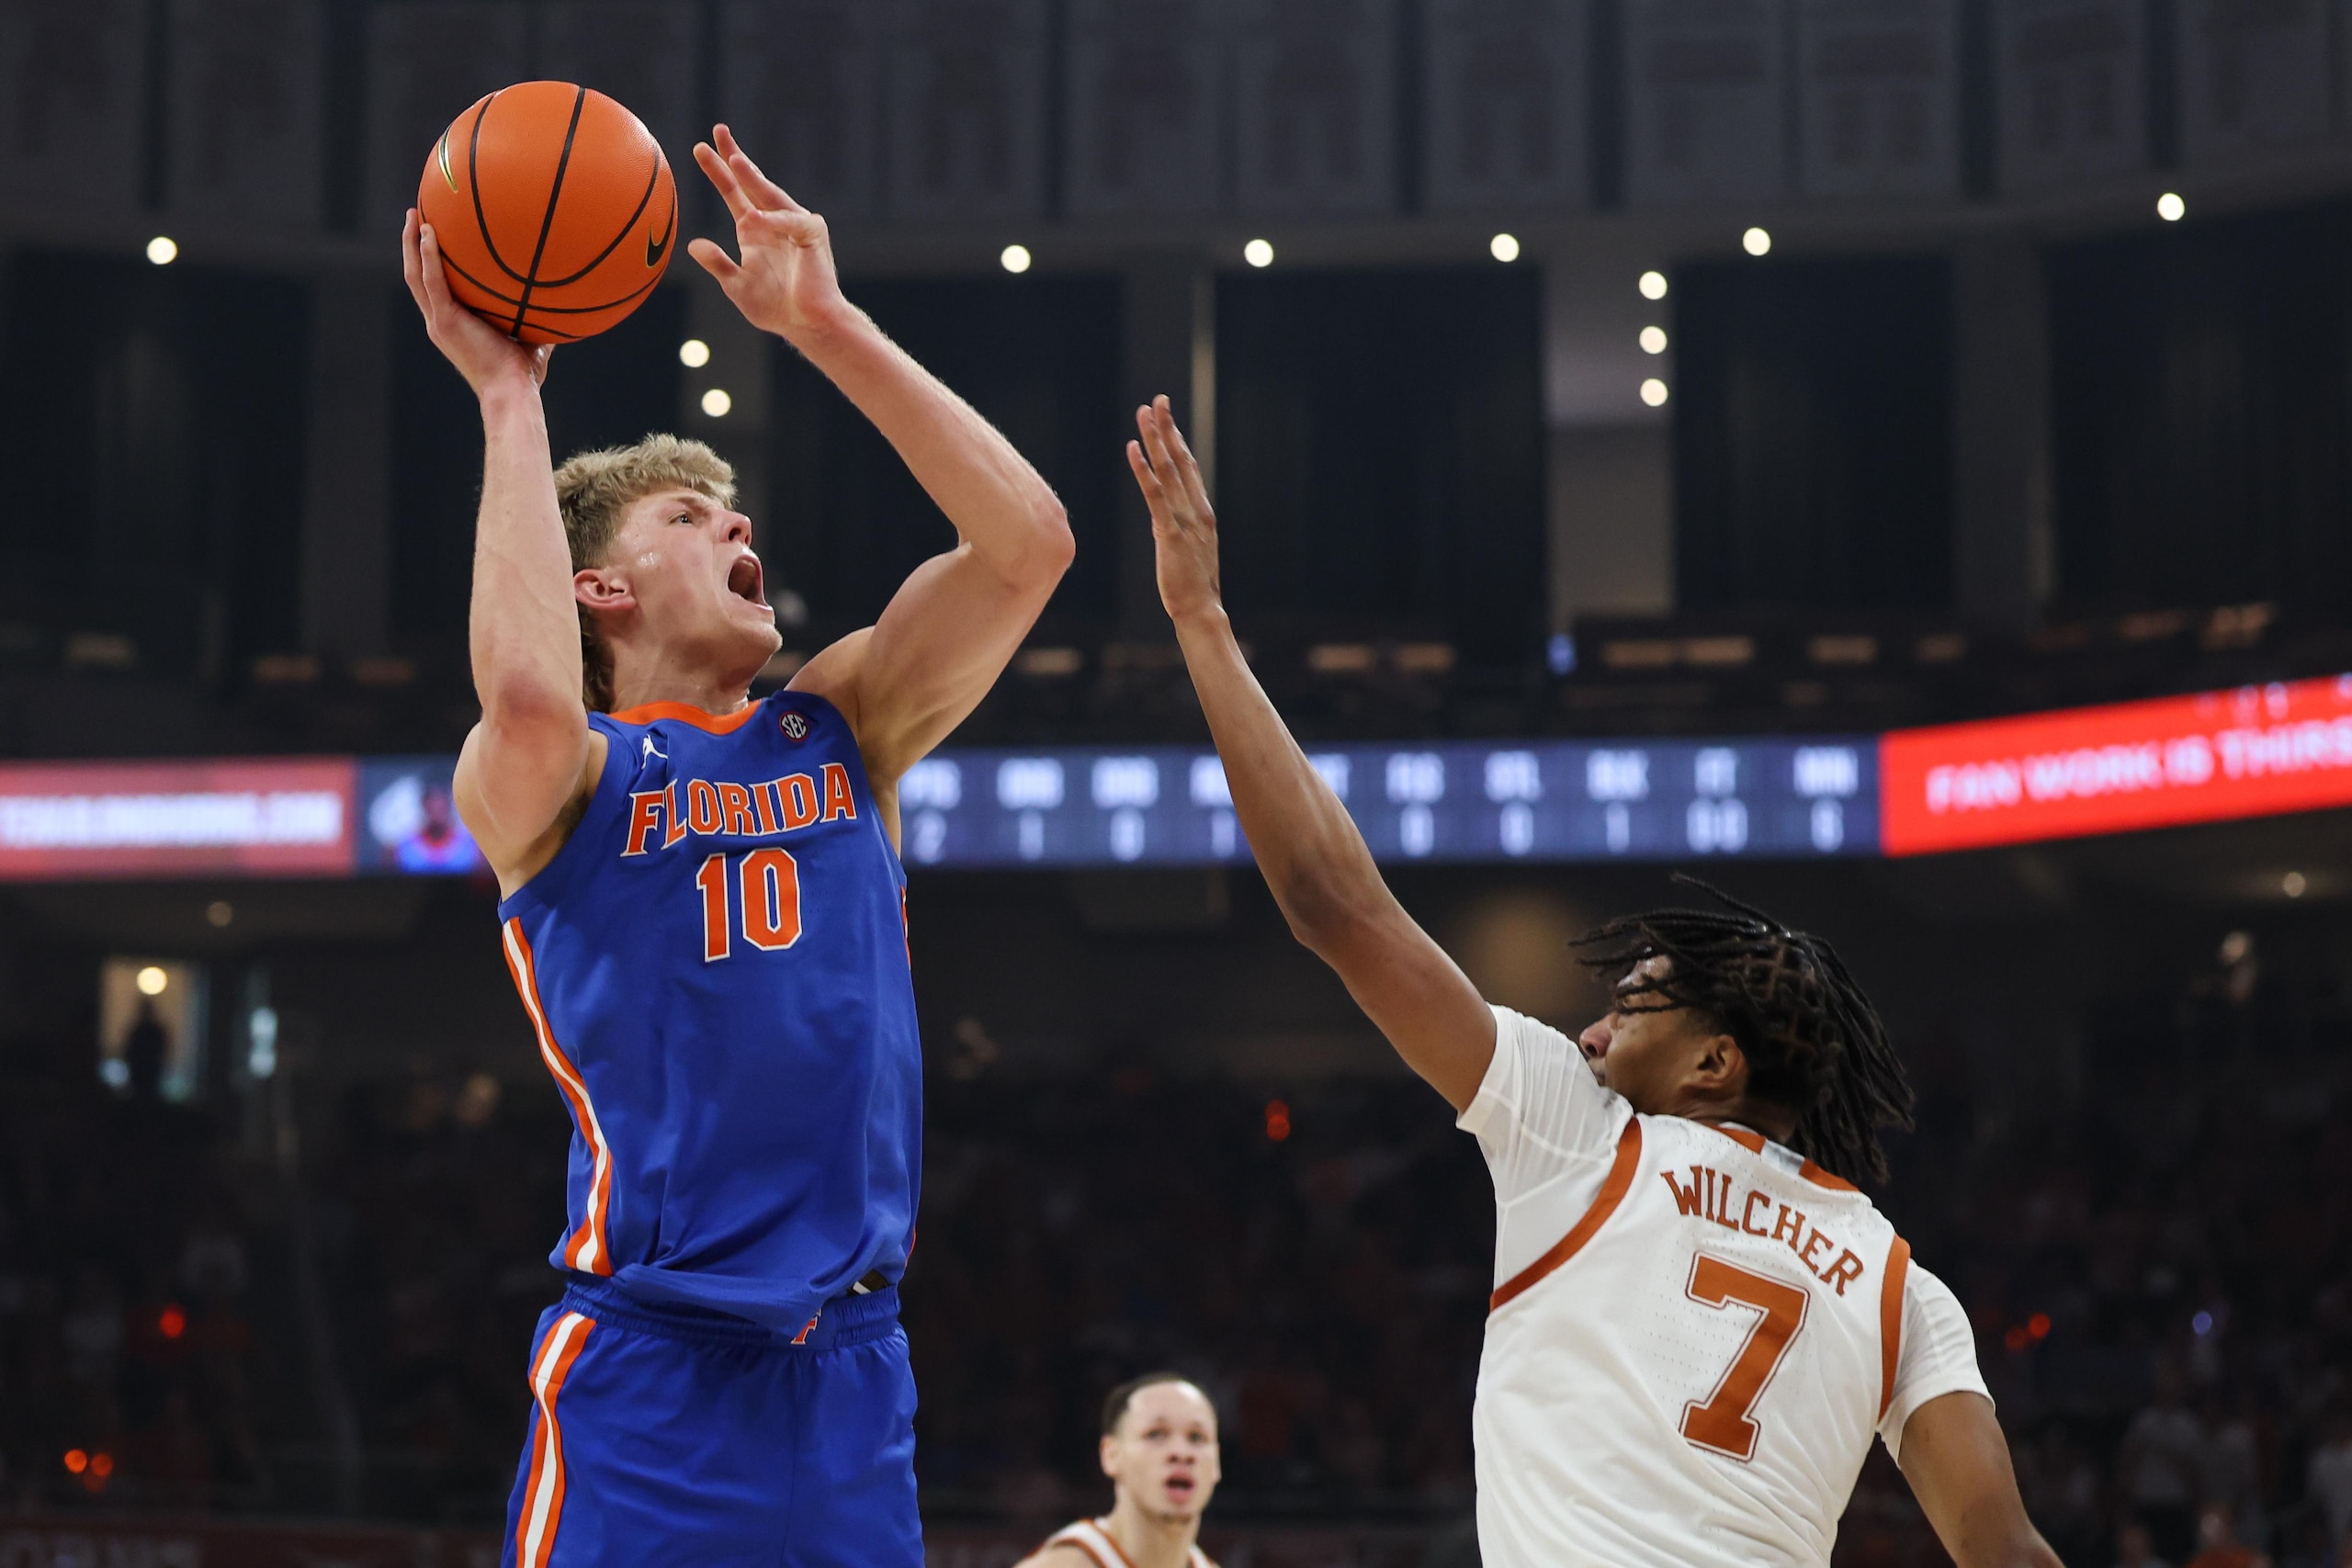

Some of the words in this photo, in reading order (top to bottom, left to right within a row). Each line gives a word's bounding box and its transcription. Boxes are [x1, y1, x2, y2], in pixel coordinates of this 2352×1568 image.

[781, 714, 808, 739] SEC
[1927, 758, 2020, 814] FAN
[2023, 741, 2163, 800] WORK
[2164, 735, 2215, 785] IS
[620, 762, 857, 857] FLORIDA
[695, 847, 802, 963] 10
[1660, 1165, 1864, 1296] WILCHER
[1679, 1250, 1810, 1462] 7
